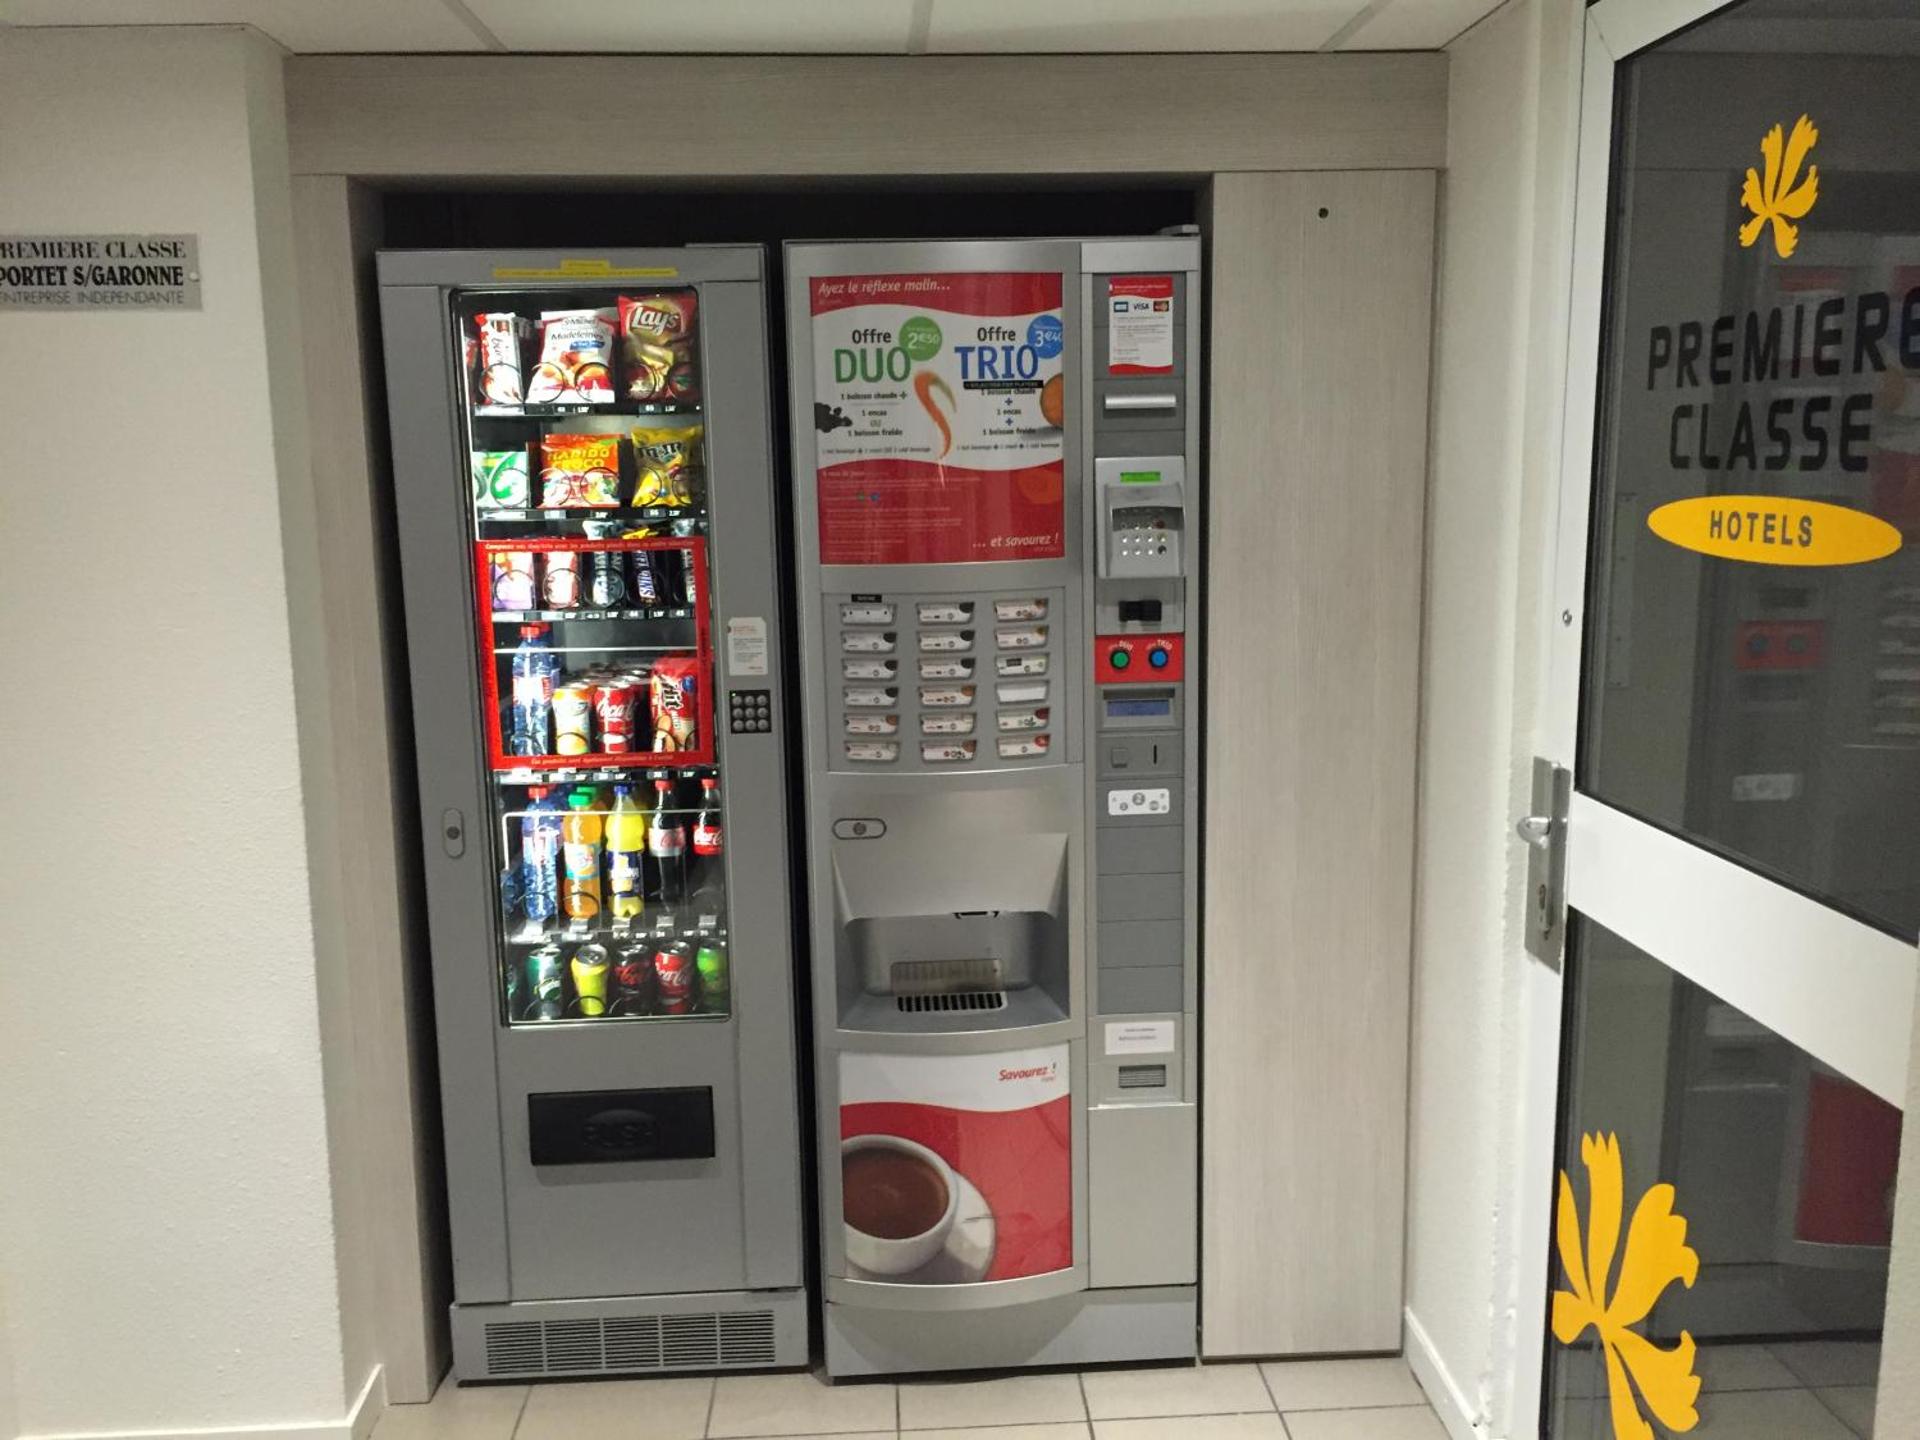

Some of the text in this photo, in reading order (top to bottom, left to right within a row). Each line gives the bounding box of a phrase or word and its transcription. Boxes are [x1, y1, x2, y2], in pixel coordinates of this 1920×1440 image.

[0, 241, 186, 259] REMIERE CLASSE
[0, 264, 184, 287] PORTET S/GARONNE
[819, 278, 950, 298] Ayez le réflexe malin...
[1133, 303, 1150, 311] VISA
[851, 329, 892, 345] Offre
[977, 327, 1016, 343] Offre
[1647, 286, 1920, 390] PREMIERE
[834, 347, 911, 384] DUO
[954, 345, 1039, 380] TRIO
[1670, 393, 1873, 472] CLASSE
[1710, 510, 1813, 548] HOTELS
[990, 536, 1001, 547] et
[1005, 535, 1051, 547] savourez
[999, 1066, 1049, 1081] Savourez
